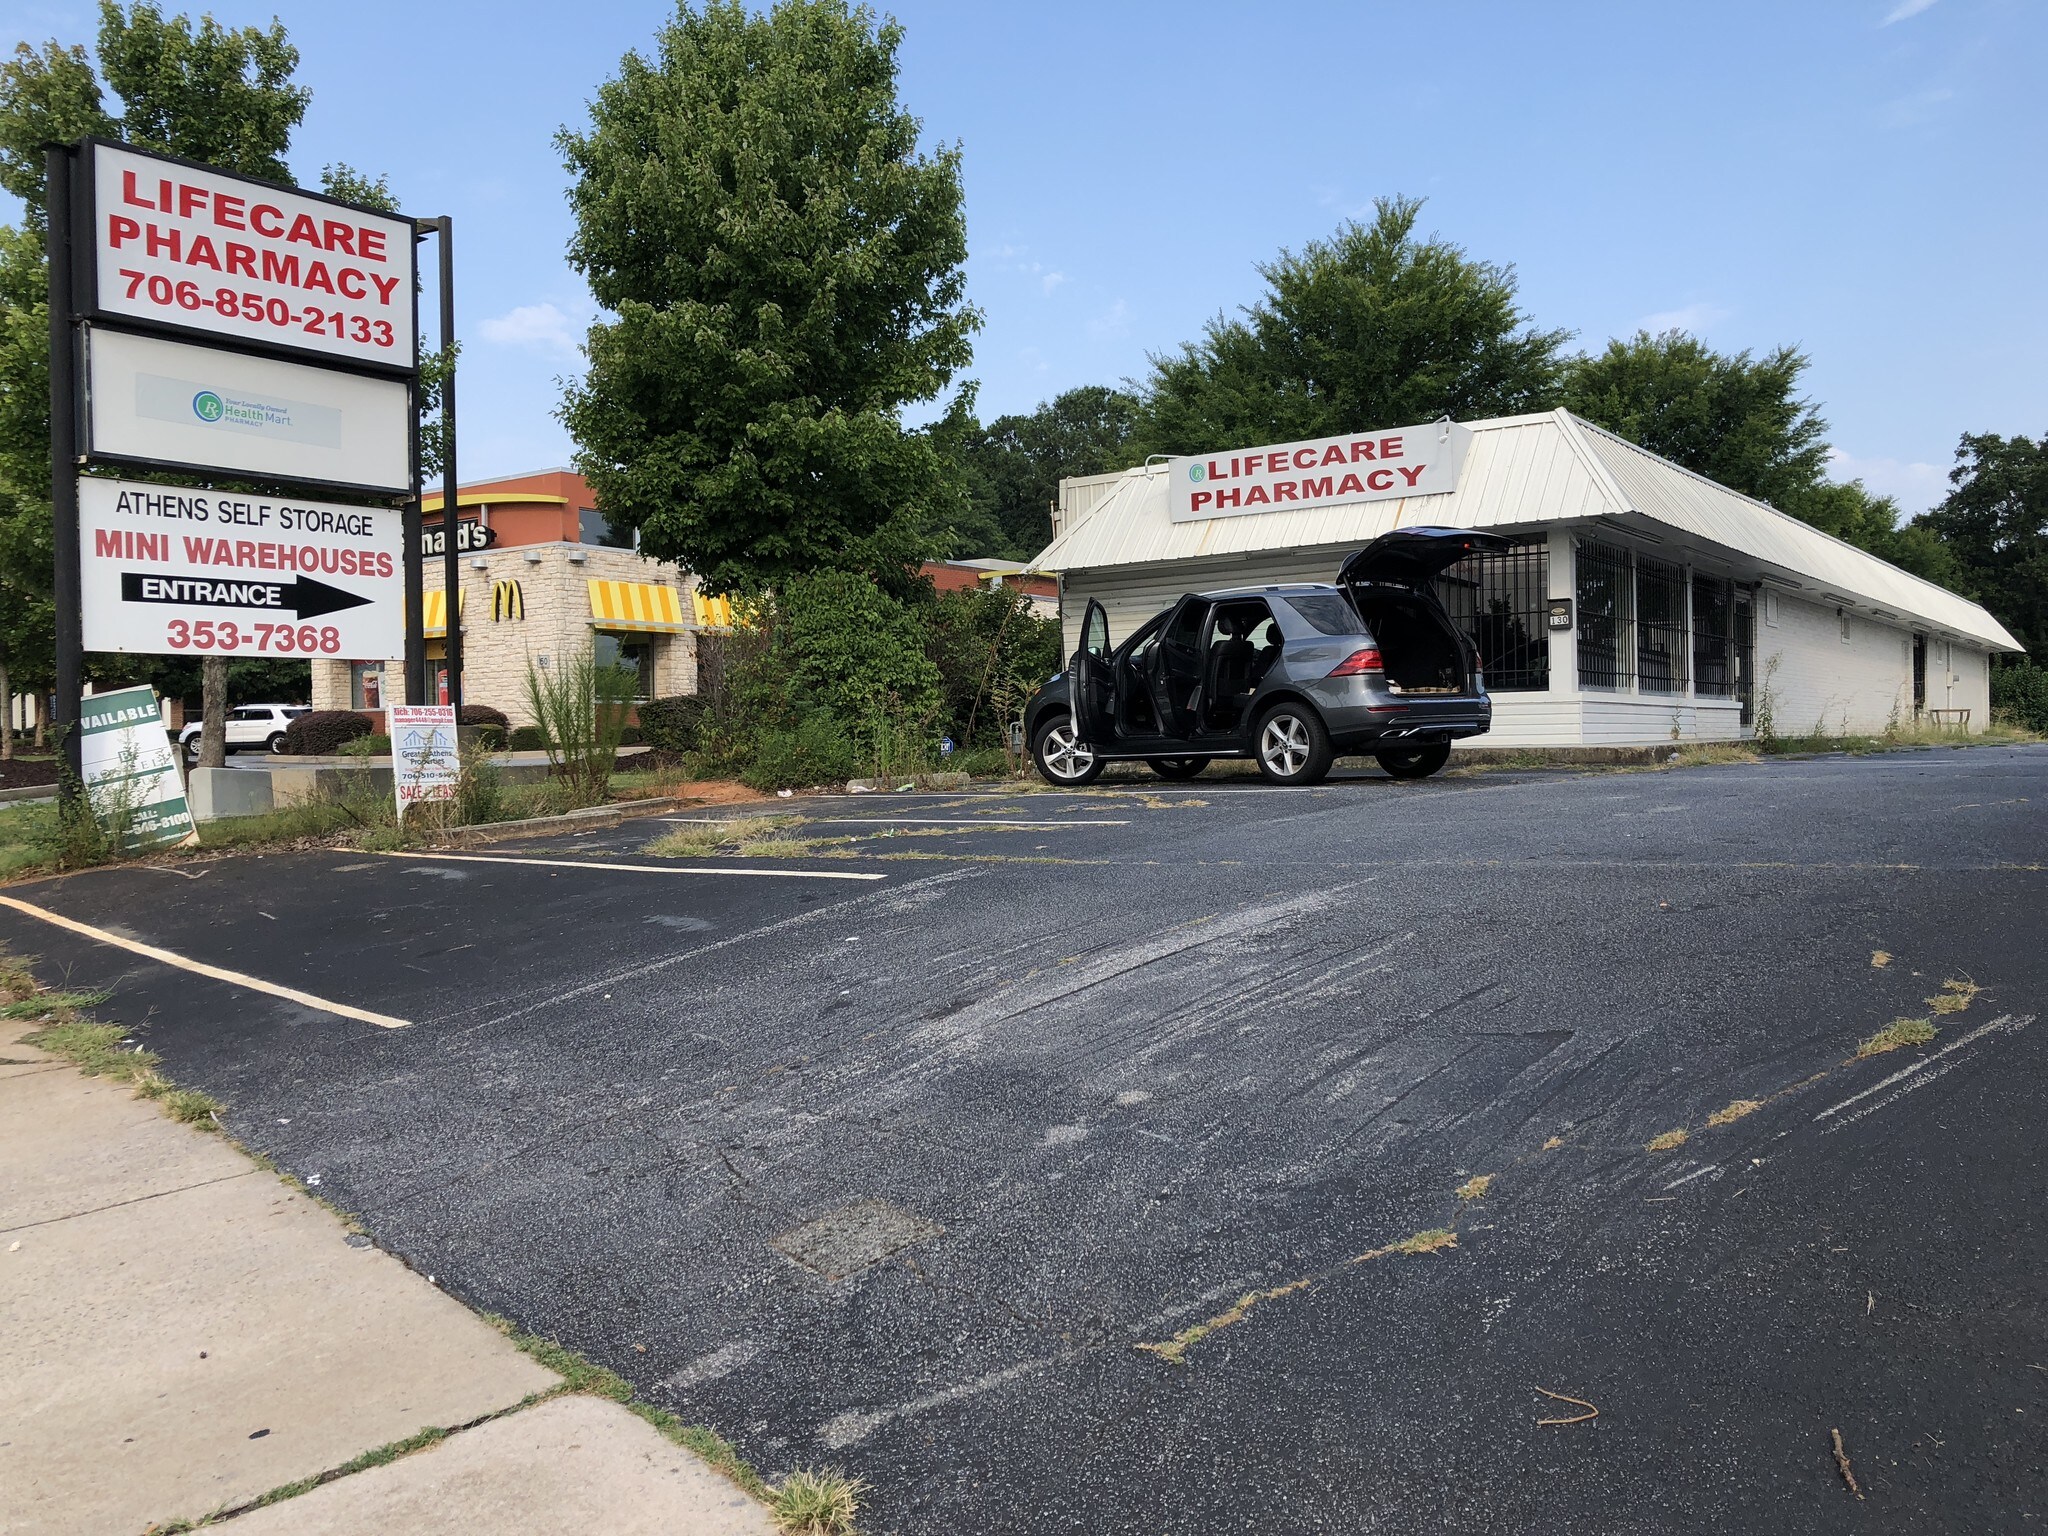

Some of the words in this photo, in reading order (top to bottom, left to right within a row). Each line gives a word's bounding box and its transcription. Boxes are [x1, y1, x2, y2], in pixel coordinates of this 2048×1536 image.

[122, 170, 387, 262] LIFECARE
[109, 214, 400, 305] PHARMACY
[118, 268, 394, 348] 706-850-2133
[225, 398, 241, 406] Your
[225, 405, 264, 421] Health
[224, 417, 263, 427] PHARMACY
[1208, 436, 1404, 481] LIFECARE
[1190, 464, 1427, 512] PHARMACY
[115, 490, 209, 522] ATHENS
[218, 500, 271, 527] SELF
[279, 506, 373, 536] STORAGE
[95, 528, 169, 563] MINI
[183, 536, 394, 578] WAREHOUSES
[422, 522, 487, 555] nad's
[142, 578, 281, 606] ENTRANCE
[167, 619, 341, 654] 353-7368
[1551, 615, 1568, 625] 130
[81, 704, 157, 730] VAILABLE
[433, 784, 456, 798] LEAS
